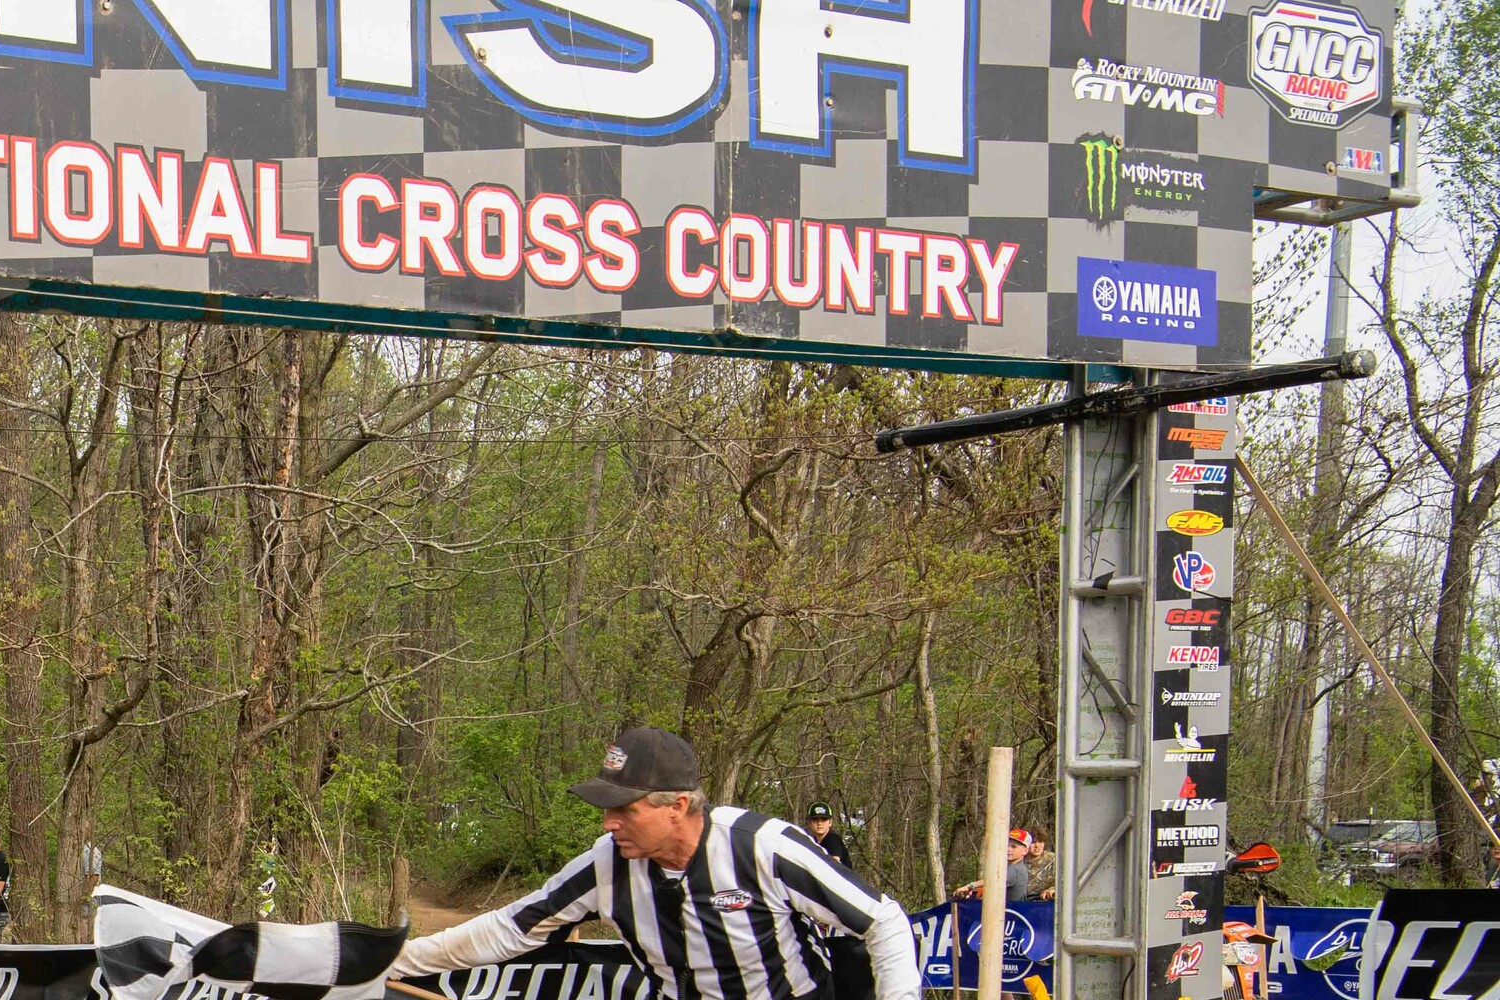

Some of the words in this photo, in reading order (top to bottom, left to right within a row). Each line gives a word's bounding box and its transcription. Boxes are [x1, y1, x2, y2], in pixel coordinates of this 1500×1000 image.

[1257, 22, 1375, 84] GNCC
[1095, 58, 1143, 81] ROCKY
[1144, 66, 1217, 92] MOUNTAIN
[1285, 74, 1349, 101] RACING
[1288, 107, 1339, 125] SPECIALIZED
[1345, 147, 1384, 172] AMA
[1121, 162, 1206, 191] MONSTER
[1134, 187, 1193, 201] ENERGY
[337, 172, 641, 293] CROSS
[666, 205, 1020, 326] COUNTRY
[1118, 281, 1202, 318] YAMAHA
[1102, 313, 1196, 329] RACING
[1168, 402, 1228, 415] UNLIMITED
[1167, 427, 1229, 445] MOOSE
[1171, 465, 1225, 483] AMSOIL
[1167, 514, 1223, 530] FMF
[1175, 554, 1203, 589] VP
[1165, 609, 1221, 625] GBC
[1169, 647, 1218, 662] KENDA
[1199, 663, 1217, 671] TIRES
[1172, 692, 1221, 701] DUNLOP
[1164, 753, 1216, 762] MICHELIN
[1161, 798, 1217, 811] TUSK
[1157, 826, 1219, 840] METHOD
[714, 893, 750, 906] GNCC
